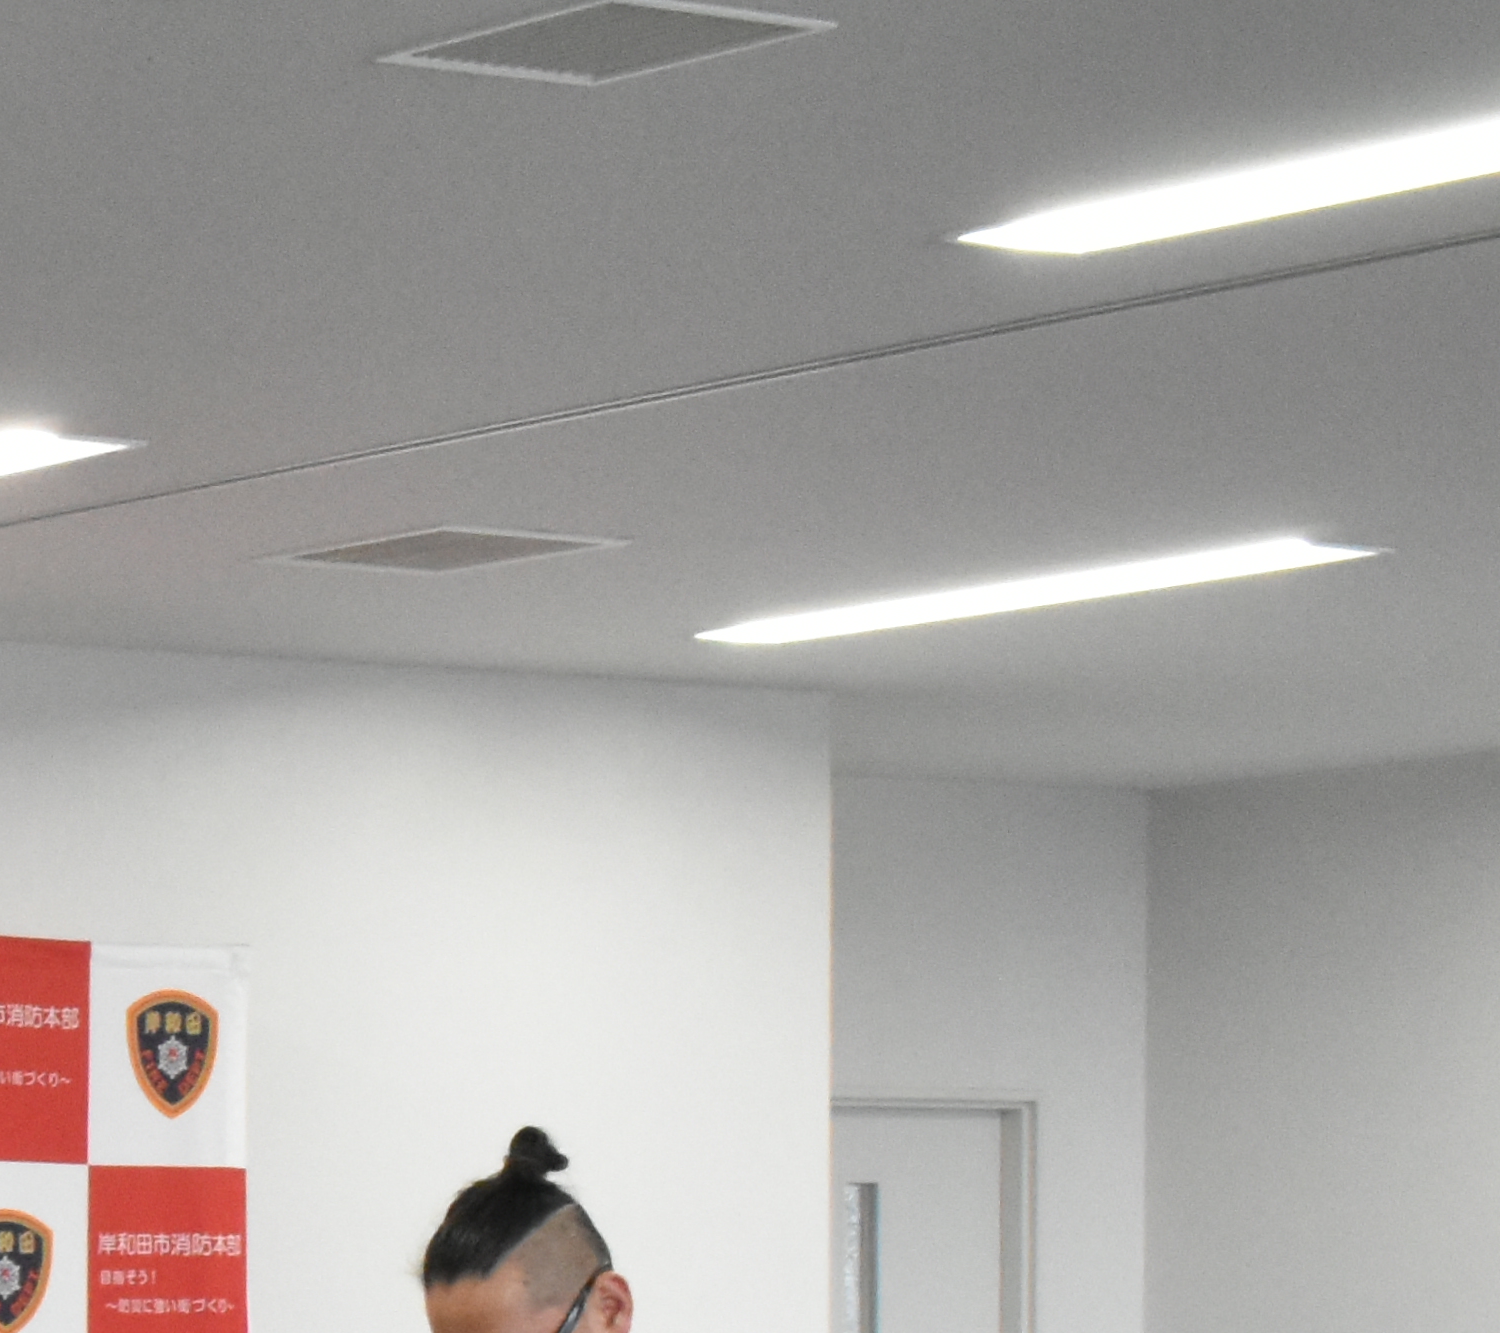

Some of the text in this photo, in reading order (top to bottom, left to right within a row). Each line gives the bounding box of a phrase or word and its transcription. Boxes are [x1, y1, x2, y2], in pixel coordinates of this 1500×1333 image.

[97, 1232, 242, 1256] 岸和田市消防本部
